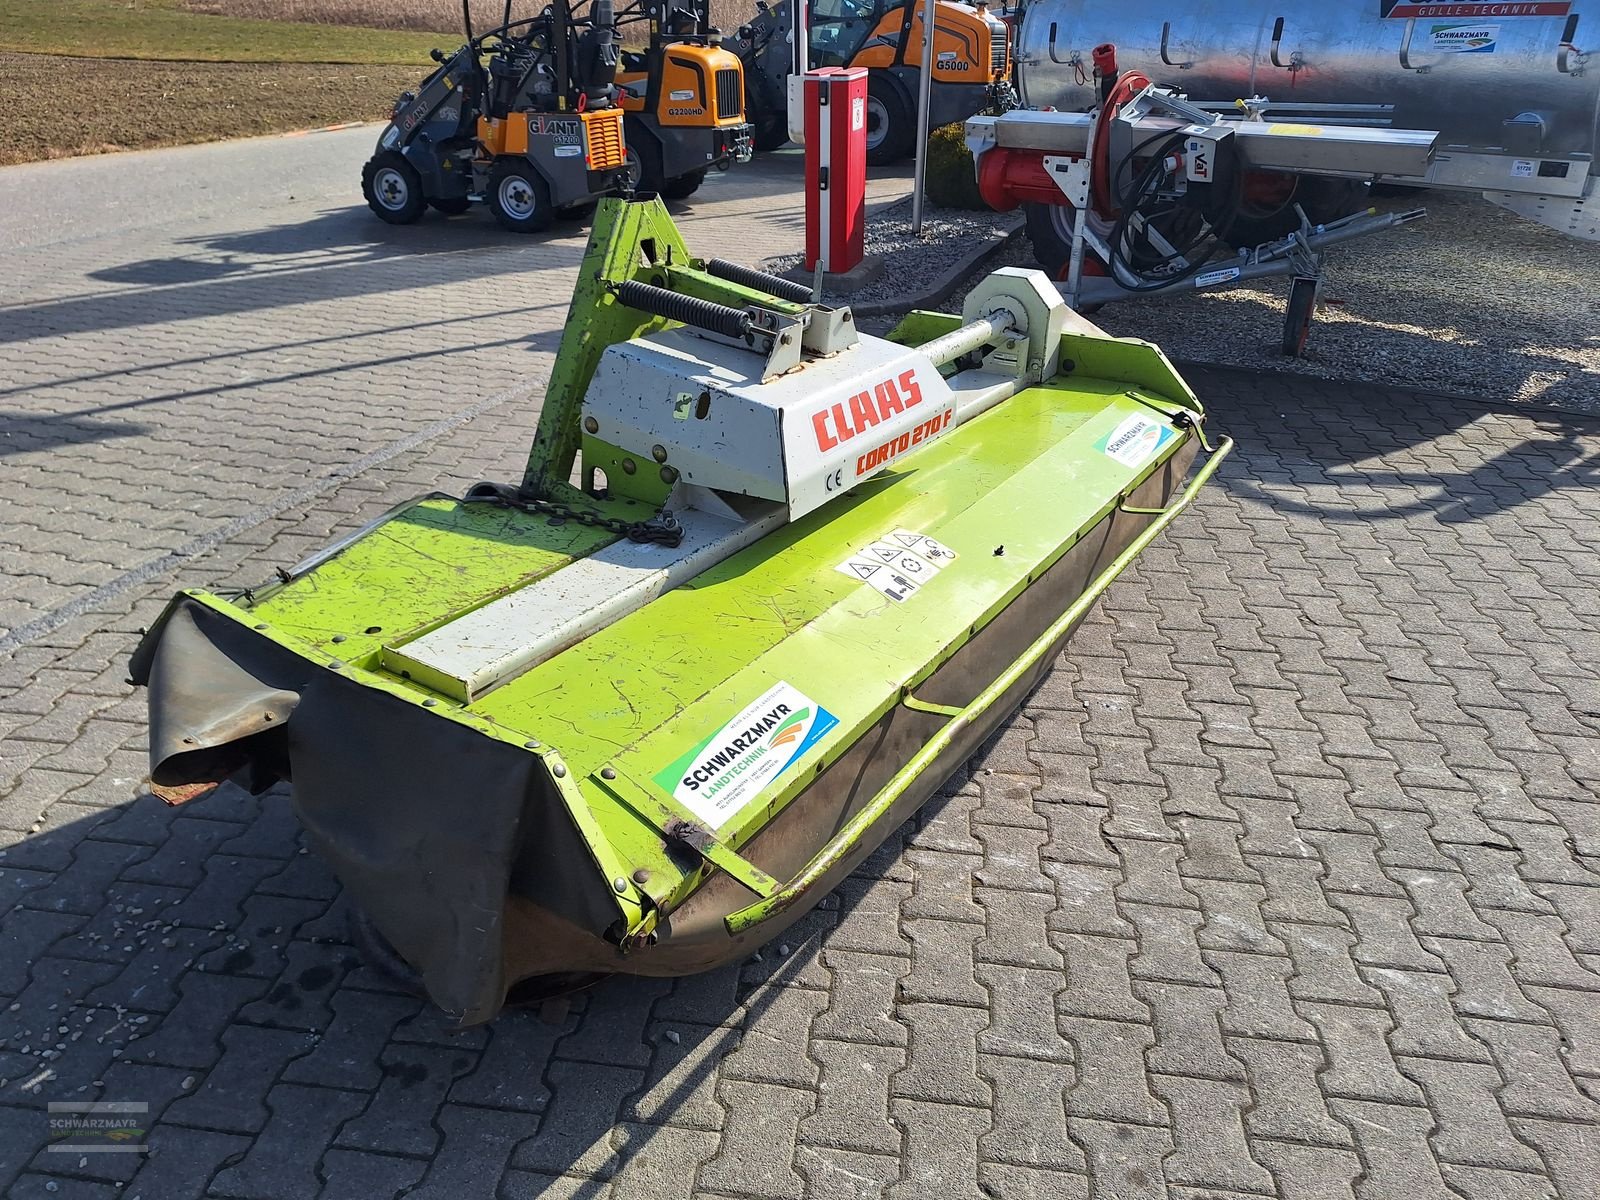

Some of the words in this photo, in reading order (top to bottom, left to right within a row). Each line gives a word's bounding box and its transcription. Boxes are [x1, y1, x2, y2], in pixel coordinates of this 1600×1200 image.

[1434, 31, 1490, 39] SCHWARZMAYR
[936, 61, 969, 71] G5000
[668, 107, 703, 116] G2200HD
[553, 135, 580, 145] G1200
[811, 368, 923, 453] CLAAS
[856, 431, 911, 477] CORTO
[911, 413, 942, 446] 270
[943, 407, 953, 429] F
[1107, 421, 1148, 454] SCHWARZMAYR
[826, 468, 843, 492] CE
[683, 703, 792, 791] SCHWARZMAYR
[701, 745, 769, 800] LANDTECHNIK
